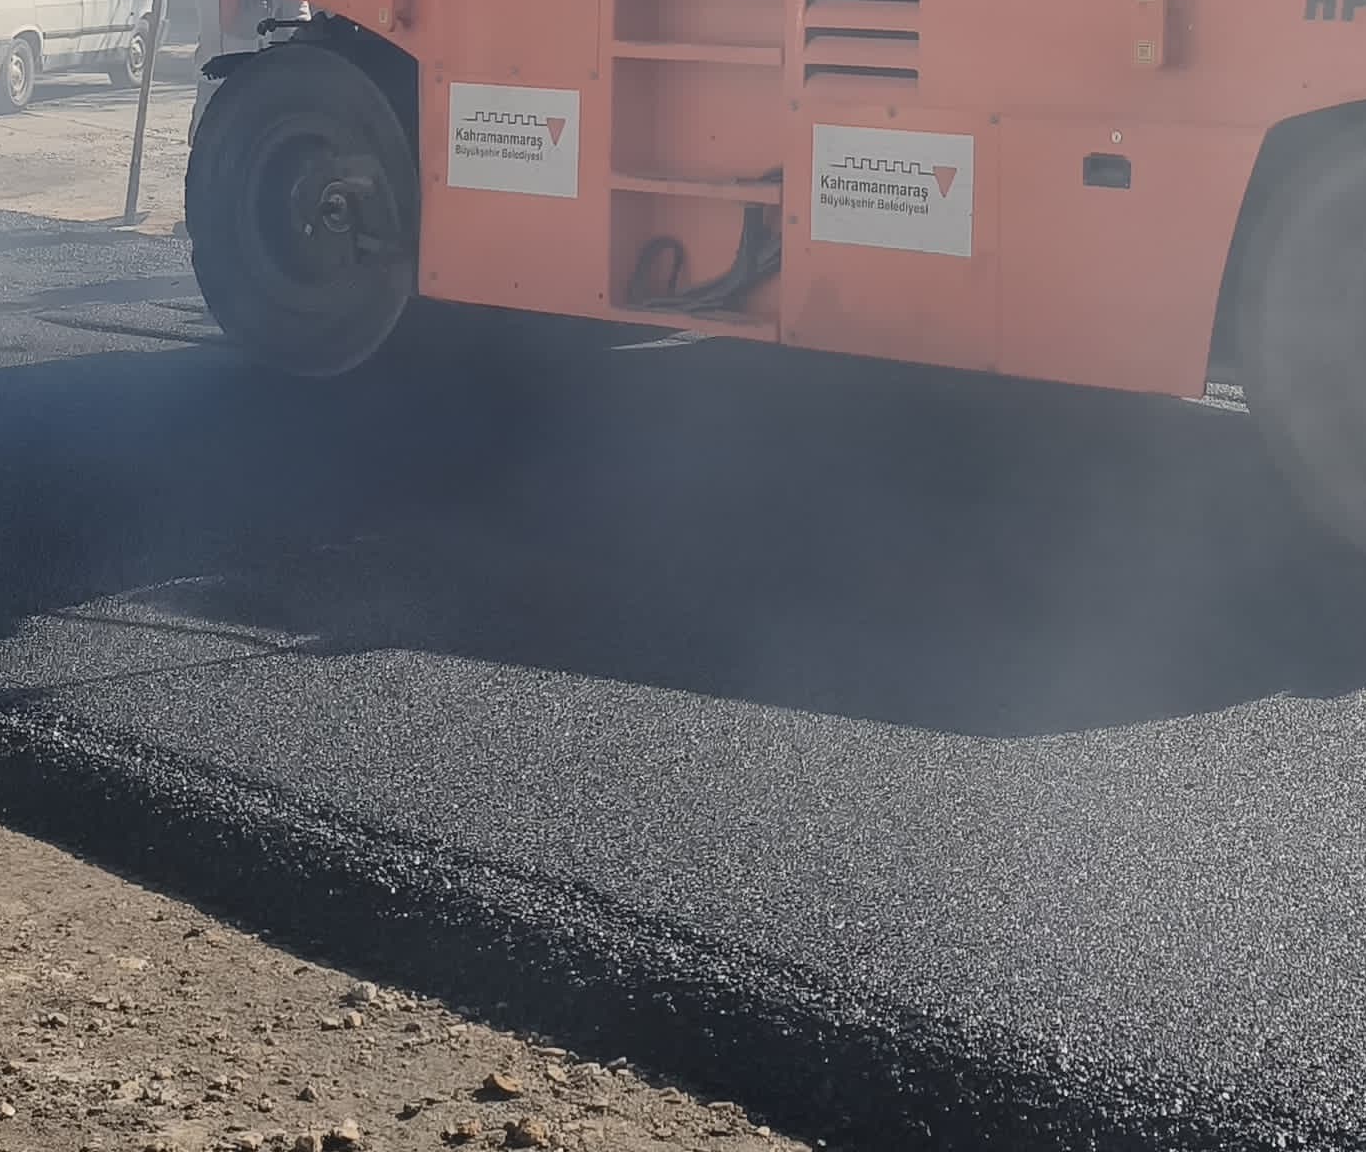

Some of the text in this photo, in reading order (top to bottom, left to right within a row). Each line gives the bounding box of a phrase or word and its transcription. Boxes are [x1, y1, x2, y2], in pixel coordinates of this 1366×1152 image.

[455, 127, 544, 150] Kahramanmaraş
[820, 175, 929, 202] Kahramanmaraş
[820, 193, 930, 217] Büyükşehir Belediyesi
